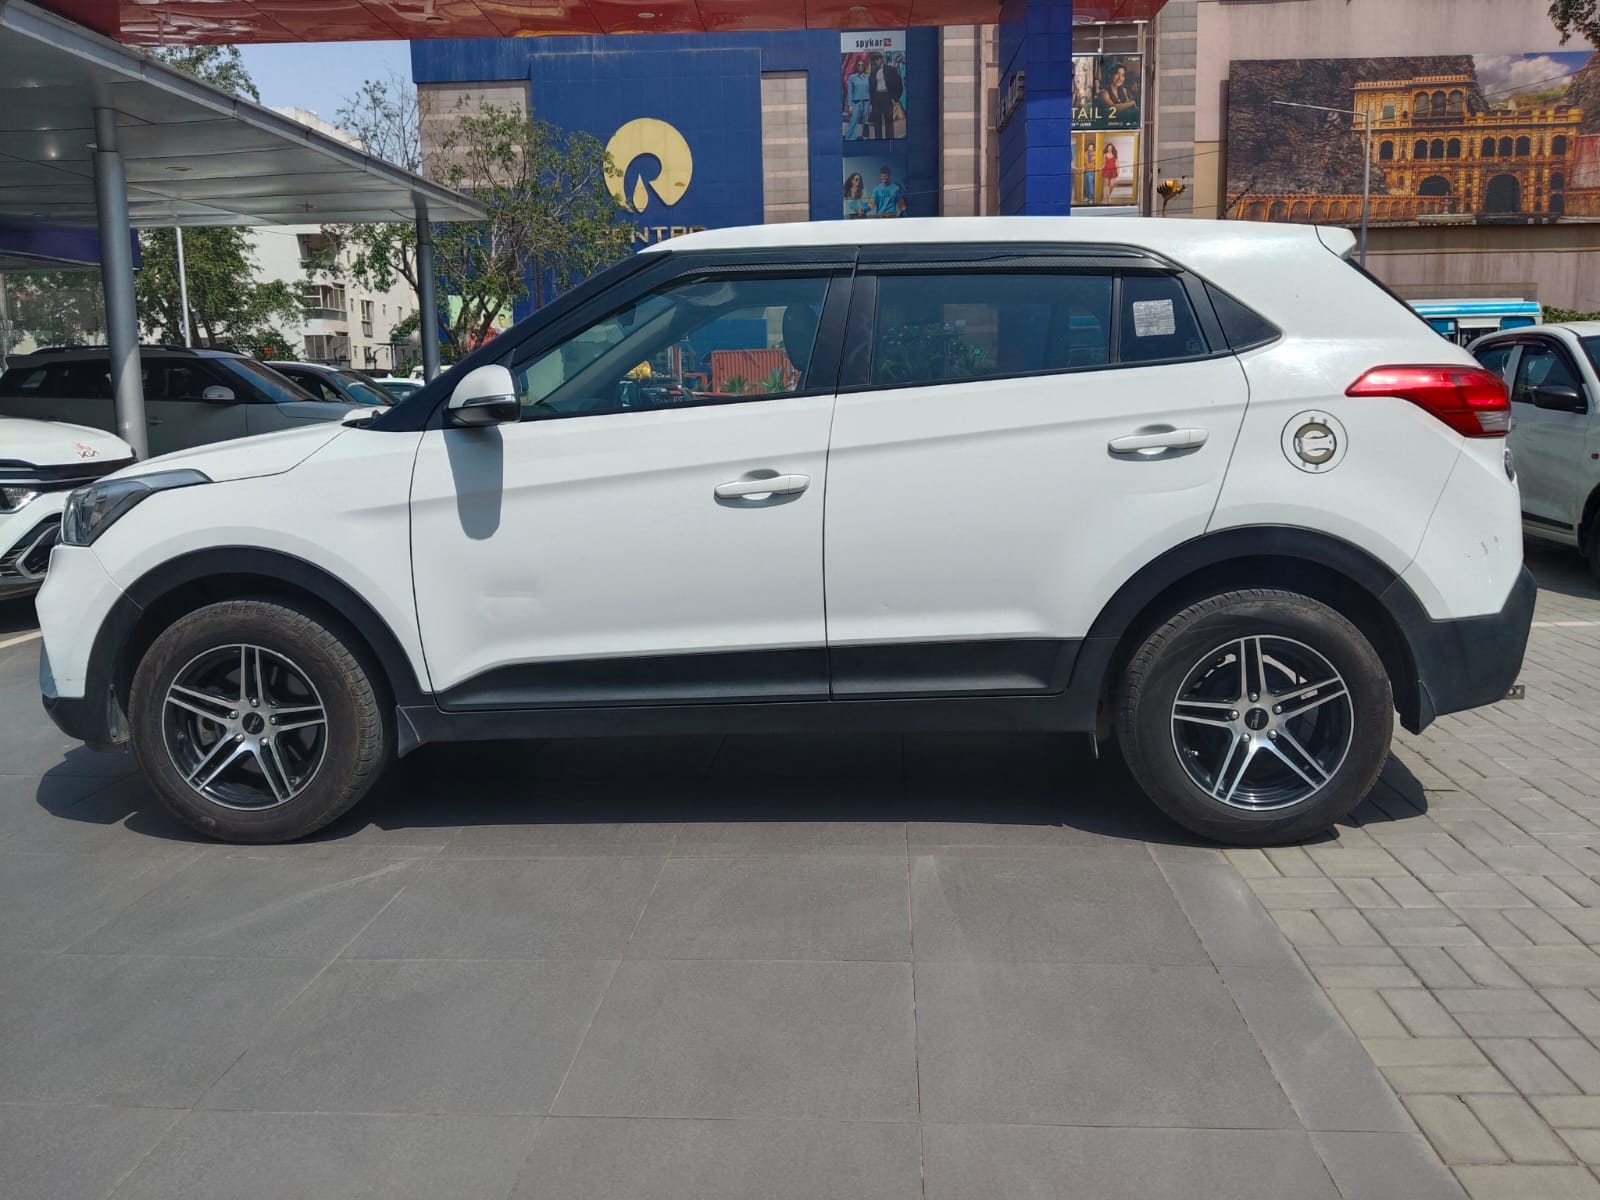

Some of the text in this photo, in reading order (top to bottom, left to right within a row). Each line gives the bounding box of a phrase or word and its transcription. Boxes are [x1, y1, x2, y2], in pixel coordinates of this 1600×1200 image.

[855, 38, 883, 48] spykar
[1072, 106, 1118, 119] TAIL 2
